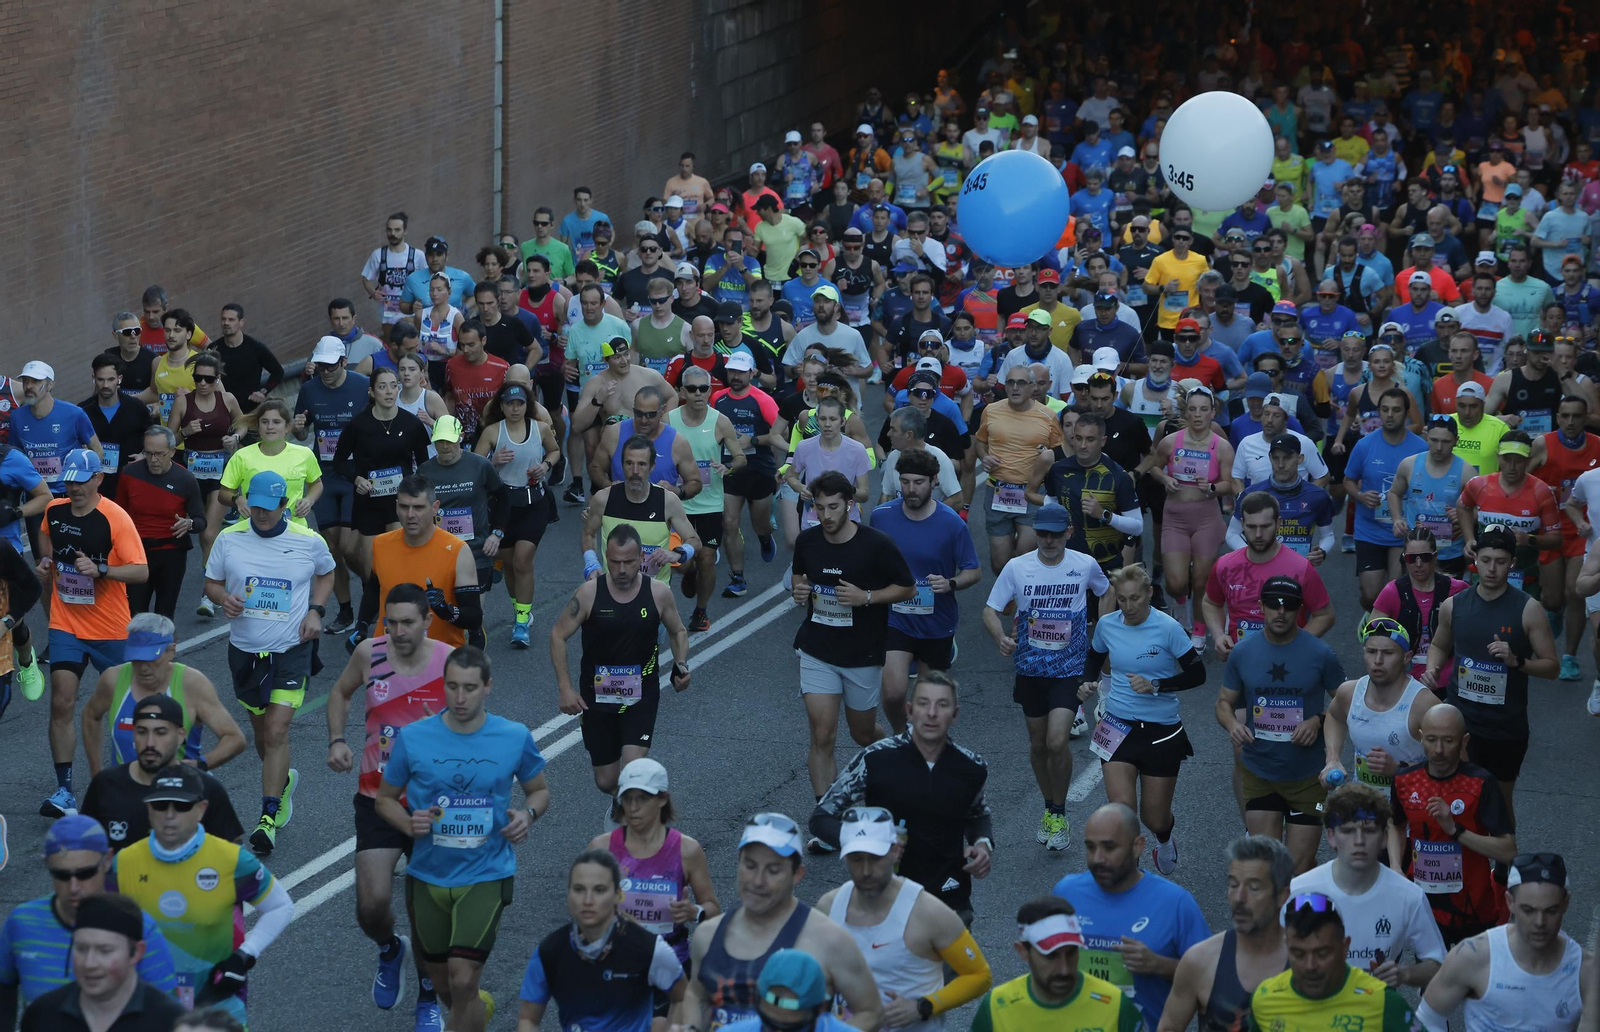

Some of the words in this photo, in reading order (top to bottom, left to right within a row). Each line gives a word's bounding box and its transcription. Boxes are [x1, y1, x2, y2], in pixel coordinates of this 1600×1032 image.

[1168, 164, 1194, 191] 3:45
[964, 172, 987, 195] 3:45
[1186, 451, 1207, 459] ZURICH
[378, 468, 399, 477] ZURICH
[998, 496, 1022, 506] PORTAL
[446, 508, 468, 516] ZURICH
[64, 565, 76, 573] ZUR
[261, 579, 288, 588] ZURICH
[261, 591, 275, 599] 5450
[1023, 585, 1033, 596] ES
[1034, 584, 1080, 596] MONTGERON
[255, 600, 279, 610] JUAN
[1251, 621, 1266, 629] ZUR
[1032, 629, 1066, 641] PATRICK
[1475, 661, 1502, 672] ZURICH
[1473, 674, 1490, 683] 10982
[602, 686, 634, 696] MARCO
[1466, 680, 1497, 694] HOBBS
[1270, 711, 1285, 720] 8288
[1104, 714, 1128, 731] ZURICH
[1275, 724, 1281, 733] Y
[1362, 772, 1392, 785] FLOOD
[453, 797, 486, 806] ZURICH
[453, 814, 472, 822] 4928
[440, 823, 464, 836] BRU
[466, 824, 484, 835] PM
[1422, 842, 1455, 852] ZURICH
[1423, 858, 1441, 868] 8203
[1428, 871, 1462, 881] TALAIA
[635, 881, 671, 892] ZURICH
[635, 898, 654, 908] 9786
[1089, 956, 1109, 966] 1443
